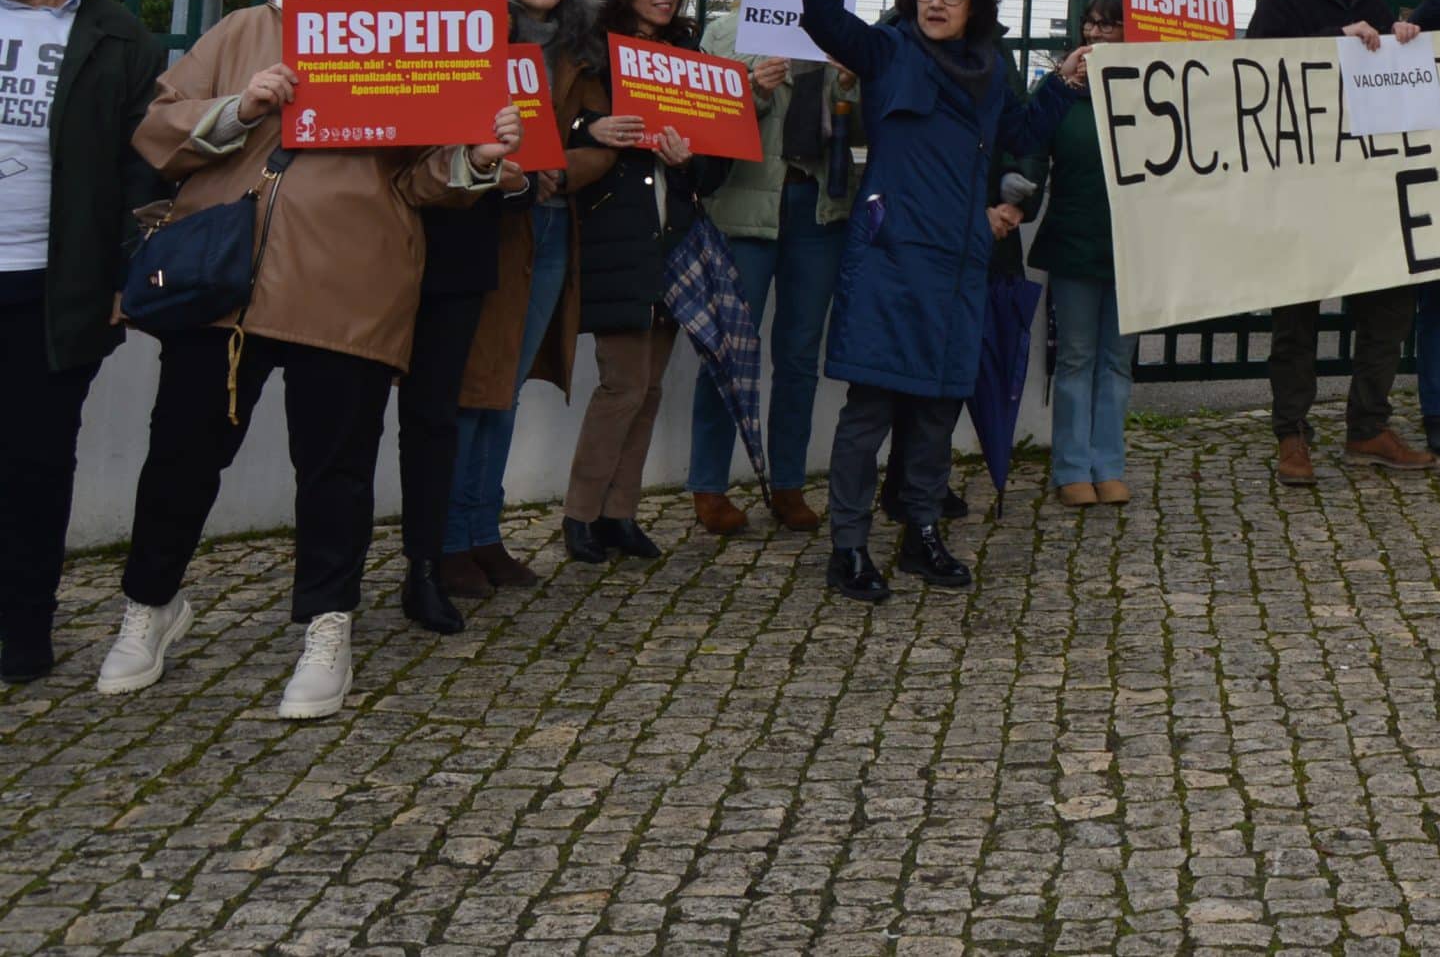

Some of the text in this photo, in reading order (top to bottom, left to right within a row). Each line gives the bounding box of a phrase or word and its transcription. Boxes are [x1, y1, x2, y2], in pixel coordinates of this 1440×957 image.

[744, 6, 798, 27] RESP
[297, 9, 494, 55] RESPEITO
[297, 58, 492, 71] Precariedade, não! Carreira recomposta.
[618, 45, 744, 98] RESPEITO
[0, 76, 35, 95] RO
[308, 70, 484, 83] Salários atualizados. Horários legais.
[1353, 67, 1433, 88] VALORIZAÇÃO
[351, 83, 440, 96] Aposentação justa!
